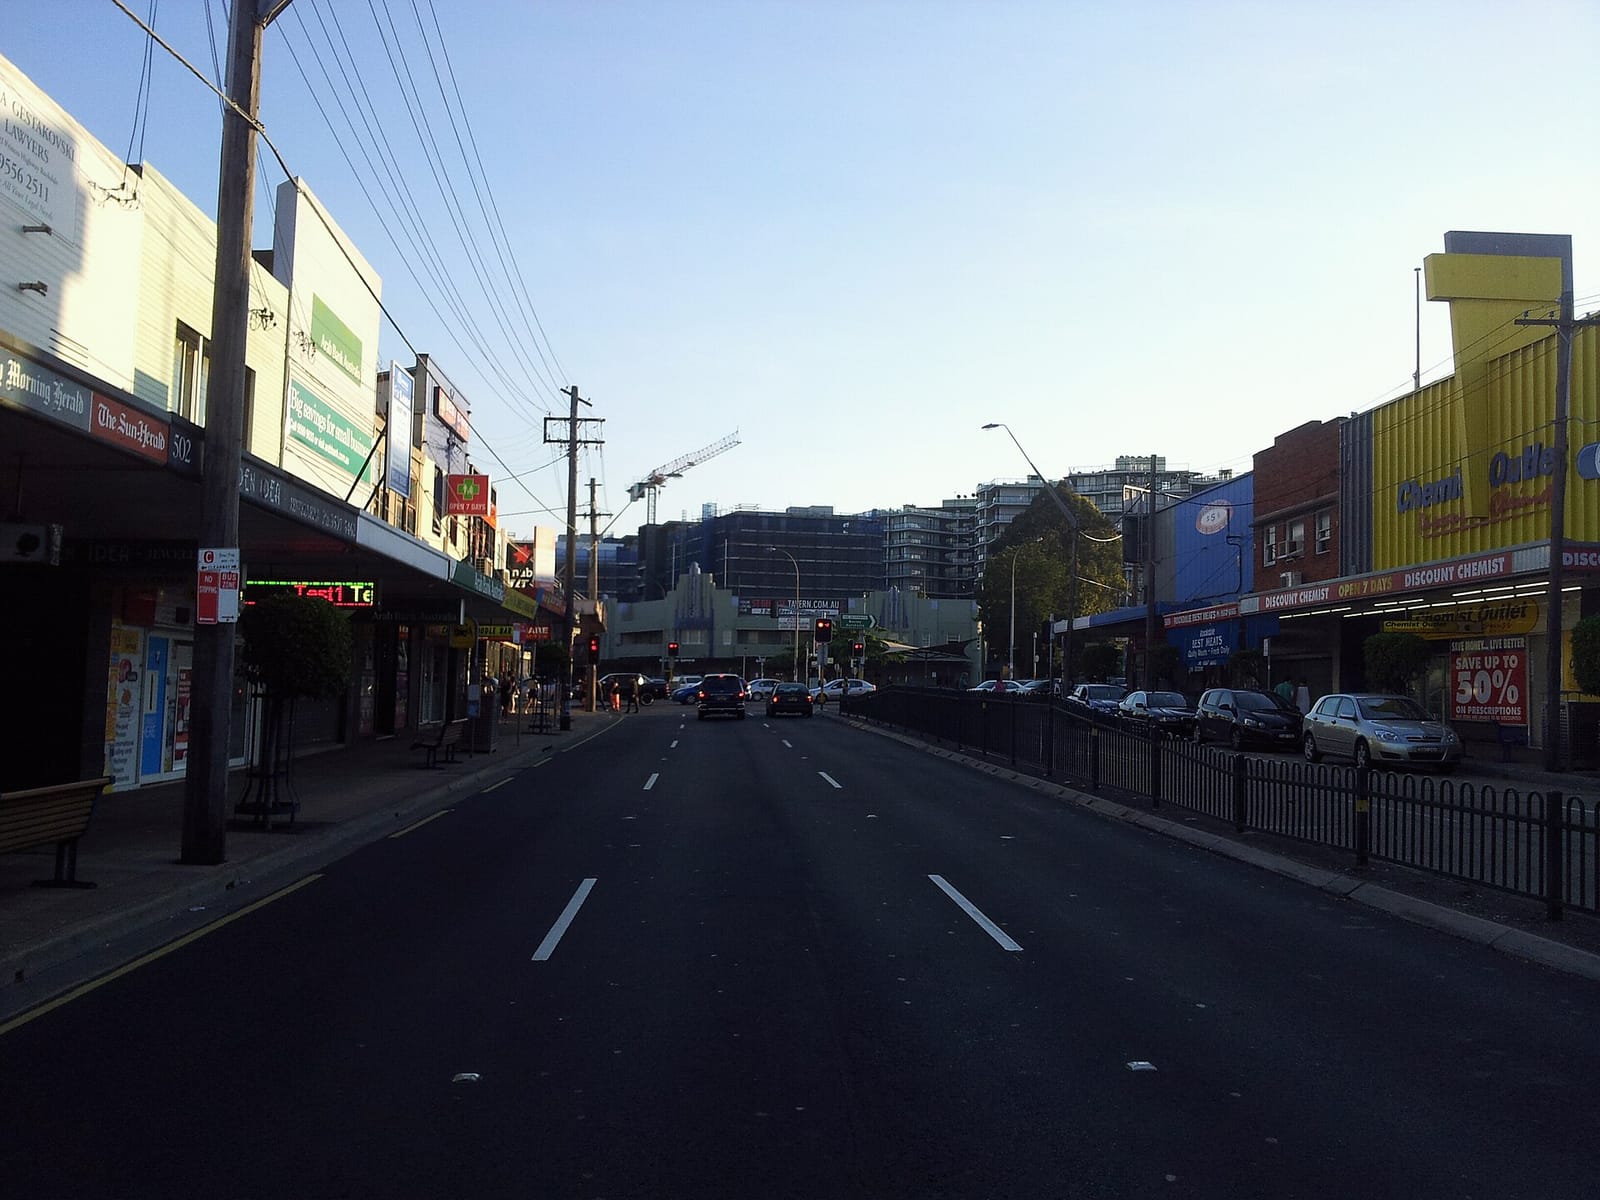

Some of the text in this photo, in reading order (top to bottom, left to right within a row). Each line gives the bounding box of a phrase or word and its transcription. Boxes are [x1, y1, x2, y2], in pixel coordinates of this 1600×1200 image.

[5, 118, 49, 164] LAWYERS
[25, 173, 49, 203] 2511
[6, 359, 50, 404] Morning
[53, 379, 84, 414] Herald
[98, 402, 166, 450] The Sun-Herald
[290, 387, 303, 418] Big
[303, 404, 326, 434] savings
[326, 414, 336, 438] for
[335, 427, 350, 445] small
[172, 434, 192, 464] 502
[1490, 442, 1556, 488] Outle
[260, 478, 281, 505] IDEA
[206, 551, 213, 562] C
[222, 572, 236, 580] BUS
[1338, 576, 1392, 597] OPEN 7 DAYS
[1404, 558, 1505, 588] DISCOUNT CHEMIST
[1265, 587, 1329, 607] DISCOUNT CHEMIST
[1478, 600, 1528, 622] Outlet
[1192, 636, 1222, 649] BEST MEATS
[1452, 641, 1464, 652] SAVE
[1490, 638, 1502, 650] LIVE
[1504, 637, 1525, 649] BETTER
[1456, 655, 1518, 669] SAVE UP TO
[1456, 670, 1519, 704] 50%
[1468, 706, 1521, 715] PRESCRIPTIONS
